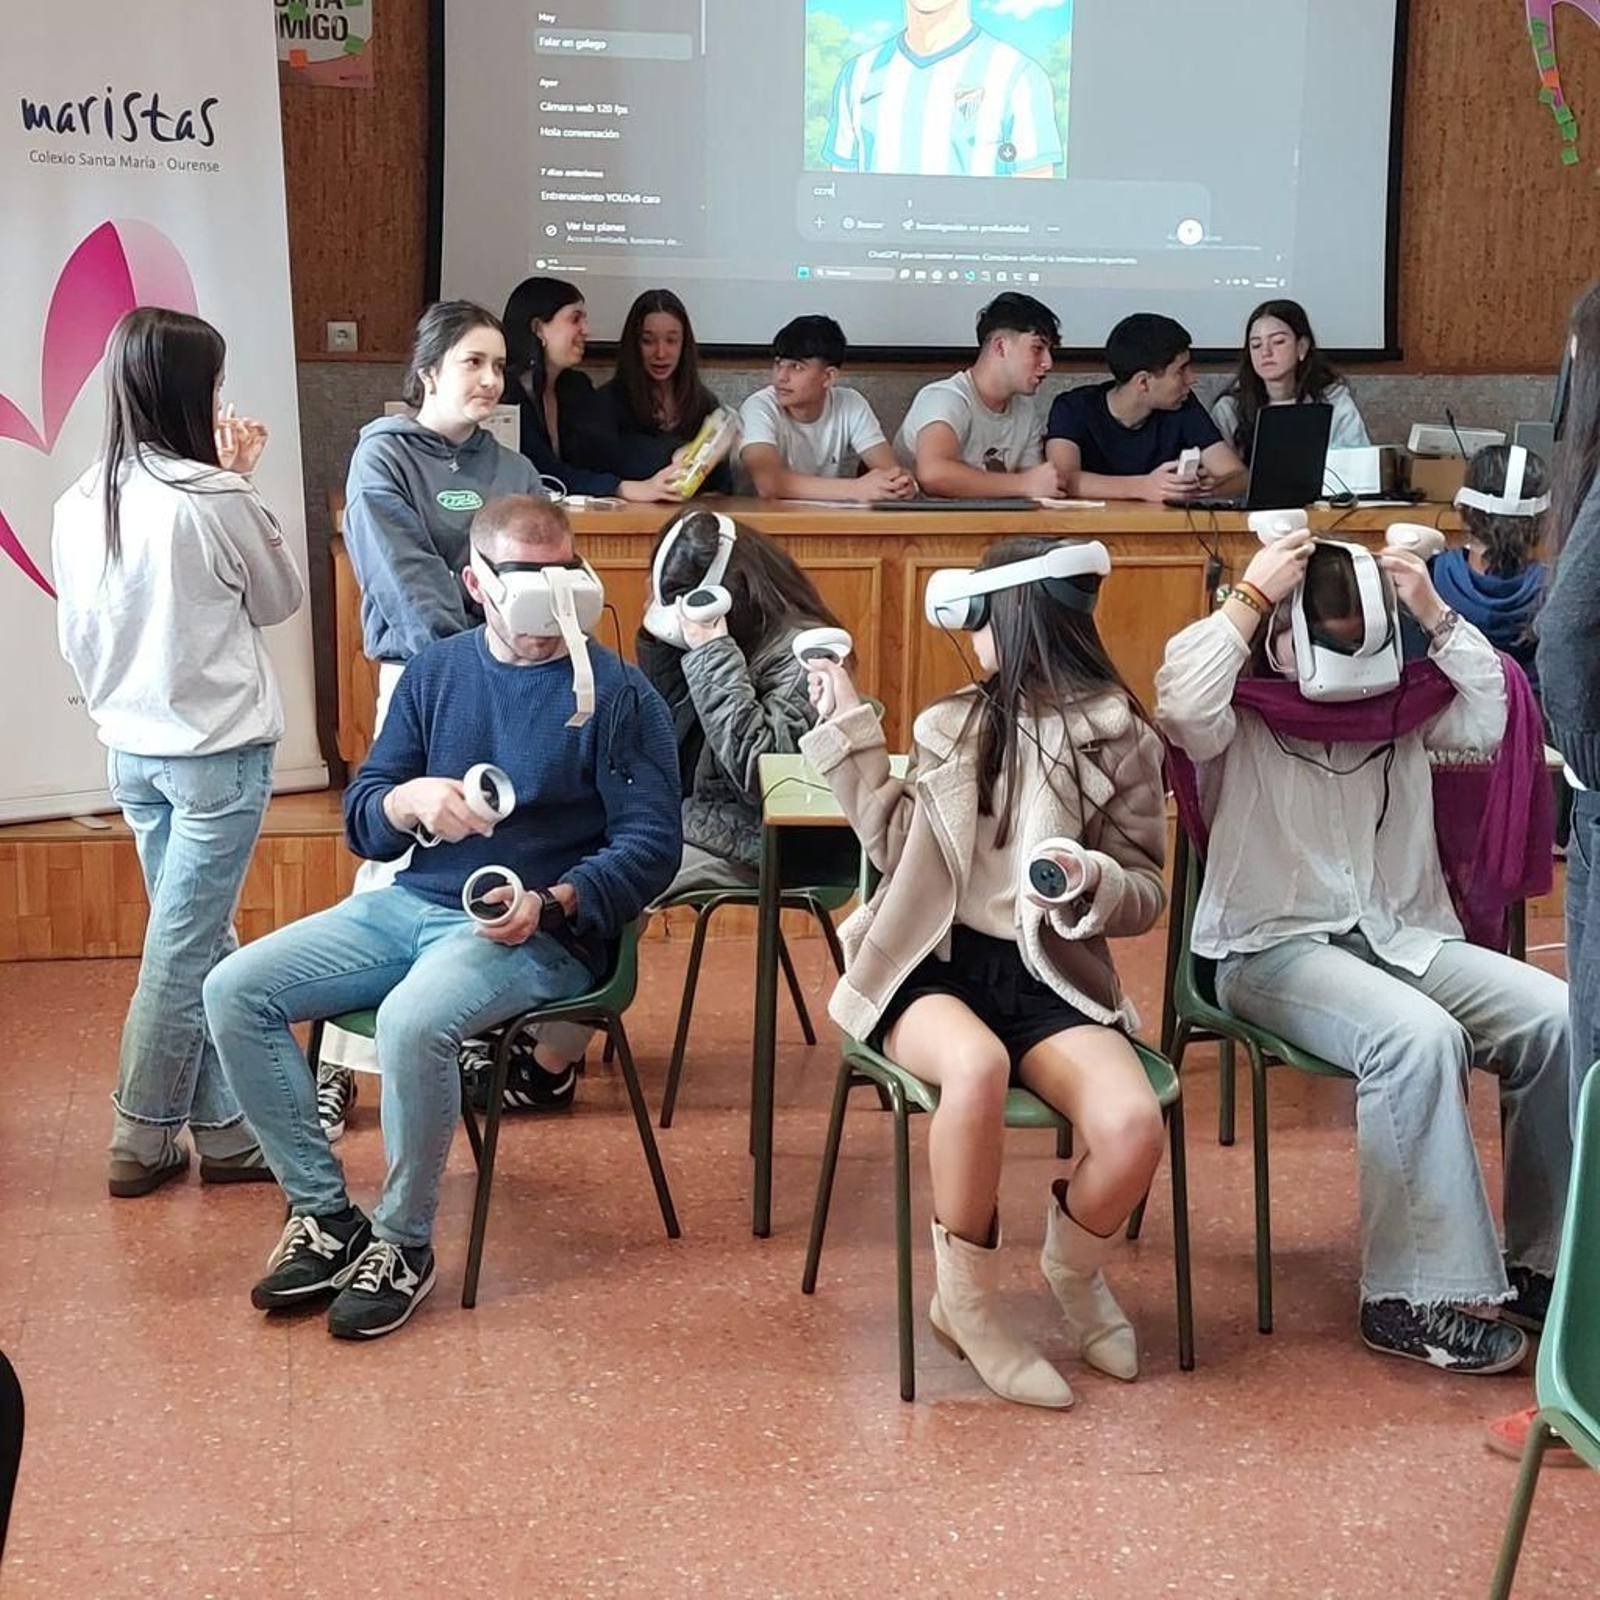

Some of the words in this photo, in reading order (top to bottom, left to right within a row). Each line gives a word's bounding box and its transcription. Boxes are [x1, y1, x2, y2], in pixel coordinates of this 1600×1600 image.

[275, 13, 348, 41] MIGO
[575, 103, 595, 113] web
[614, 104, 630, 116] fps
[21, 86, 219, 147] maristas
[540, 127, 561, 137] Hola
[562, 128, 620, 138] conversación
[29, 150, 76, 166] Colexio
[78, 152, 116, 168] Santa
[166, 156, 220, 173] Ourense
[541, 191, 604, 202] Entrenamiento
[565, 221, 581, 231] Ver
[582, 221, 596, 231] los
[597, 222, 626, 233] planes
